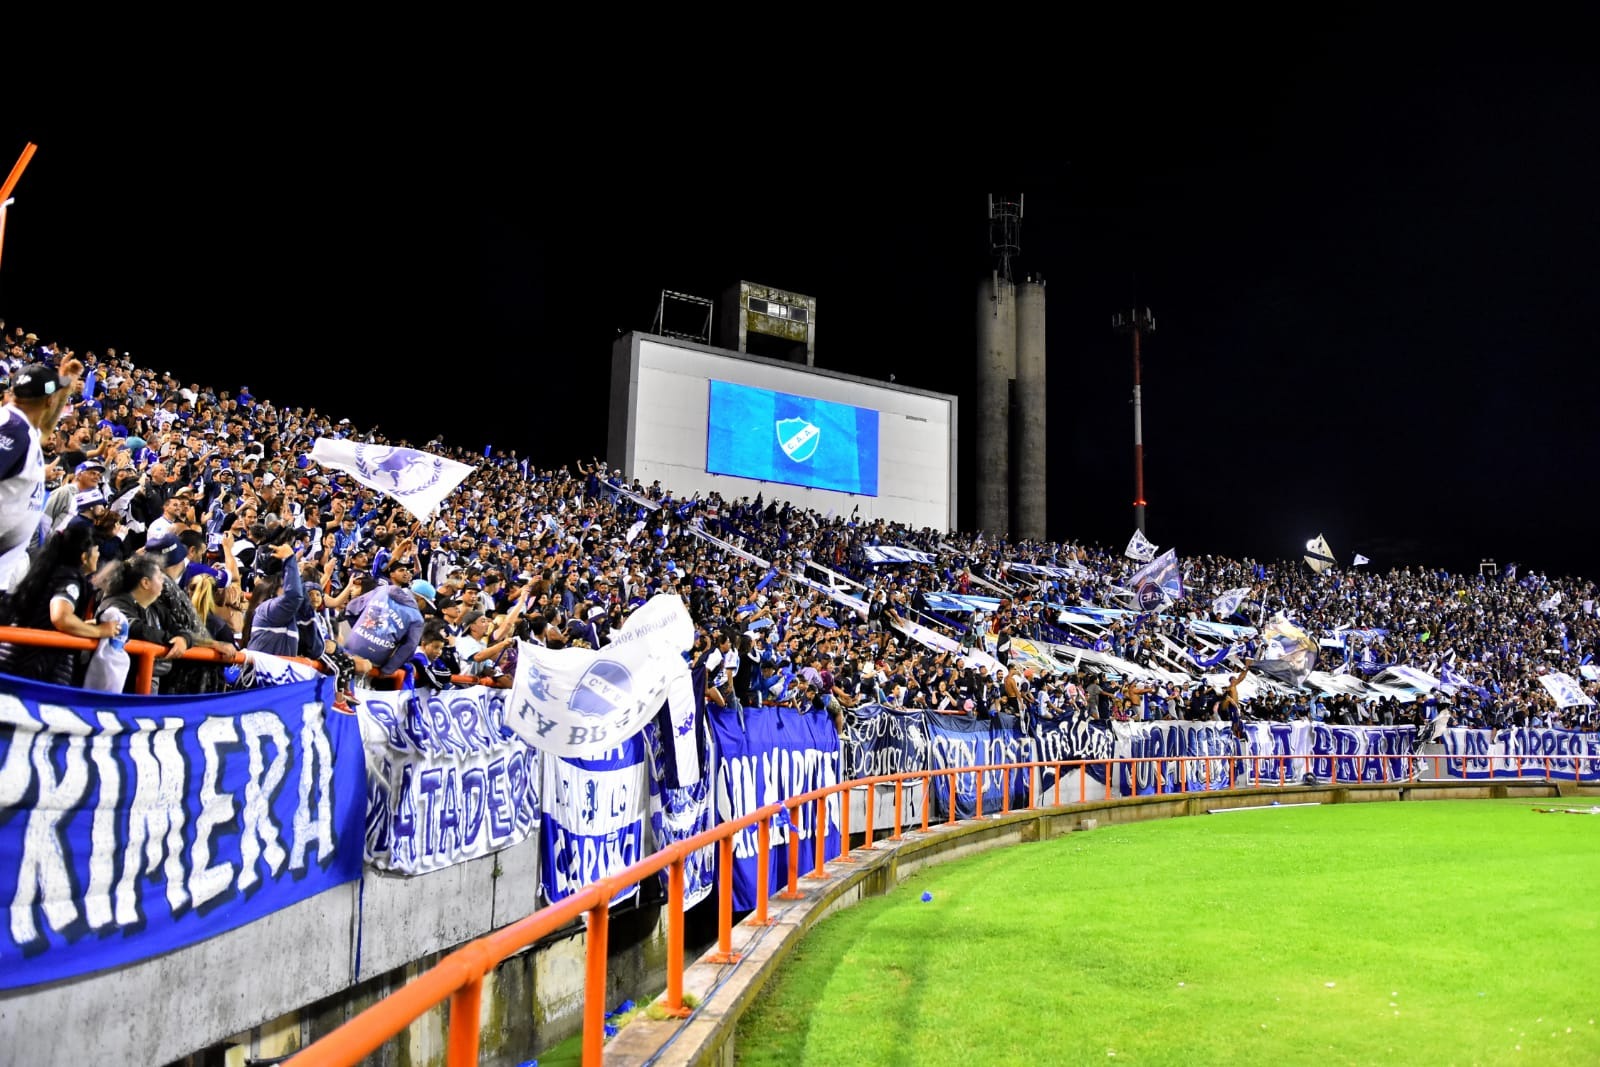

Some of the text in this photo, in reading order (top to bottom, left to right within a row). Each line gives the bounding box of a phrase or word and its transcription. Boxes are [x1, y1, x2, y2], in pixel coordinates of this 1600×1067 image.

[354, 627, 396, 649] ALVARADO
[365, 691, 508, 755] BARRIO
[1246, 723, 1297, 780] LA
[1450, 729, 1489, 768] LAS
[1498, 727, 1583, 769] TORRES
[932, 734, 977, 795] SAN
